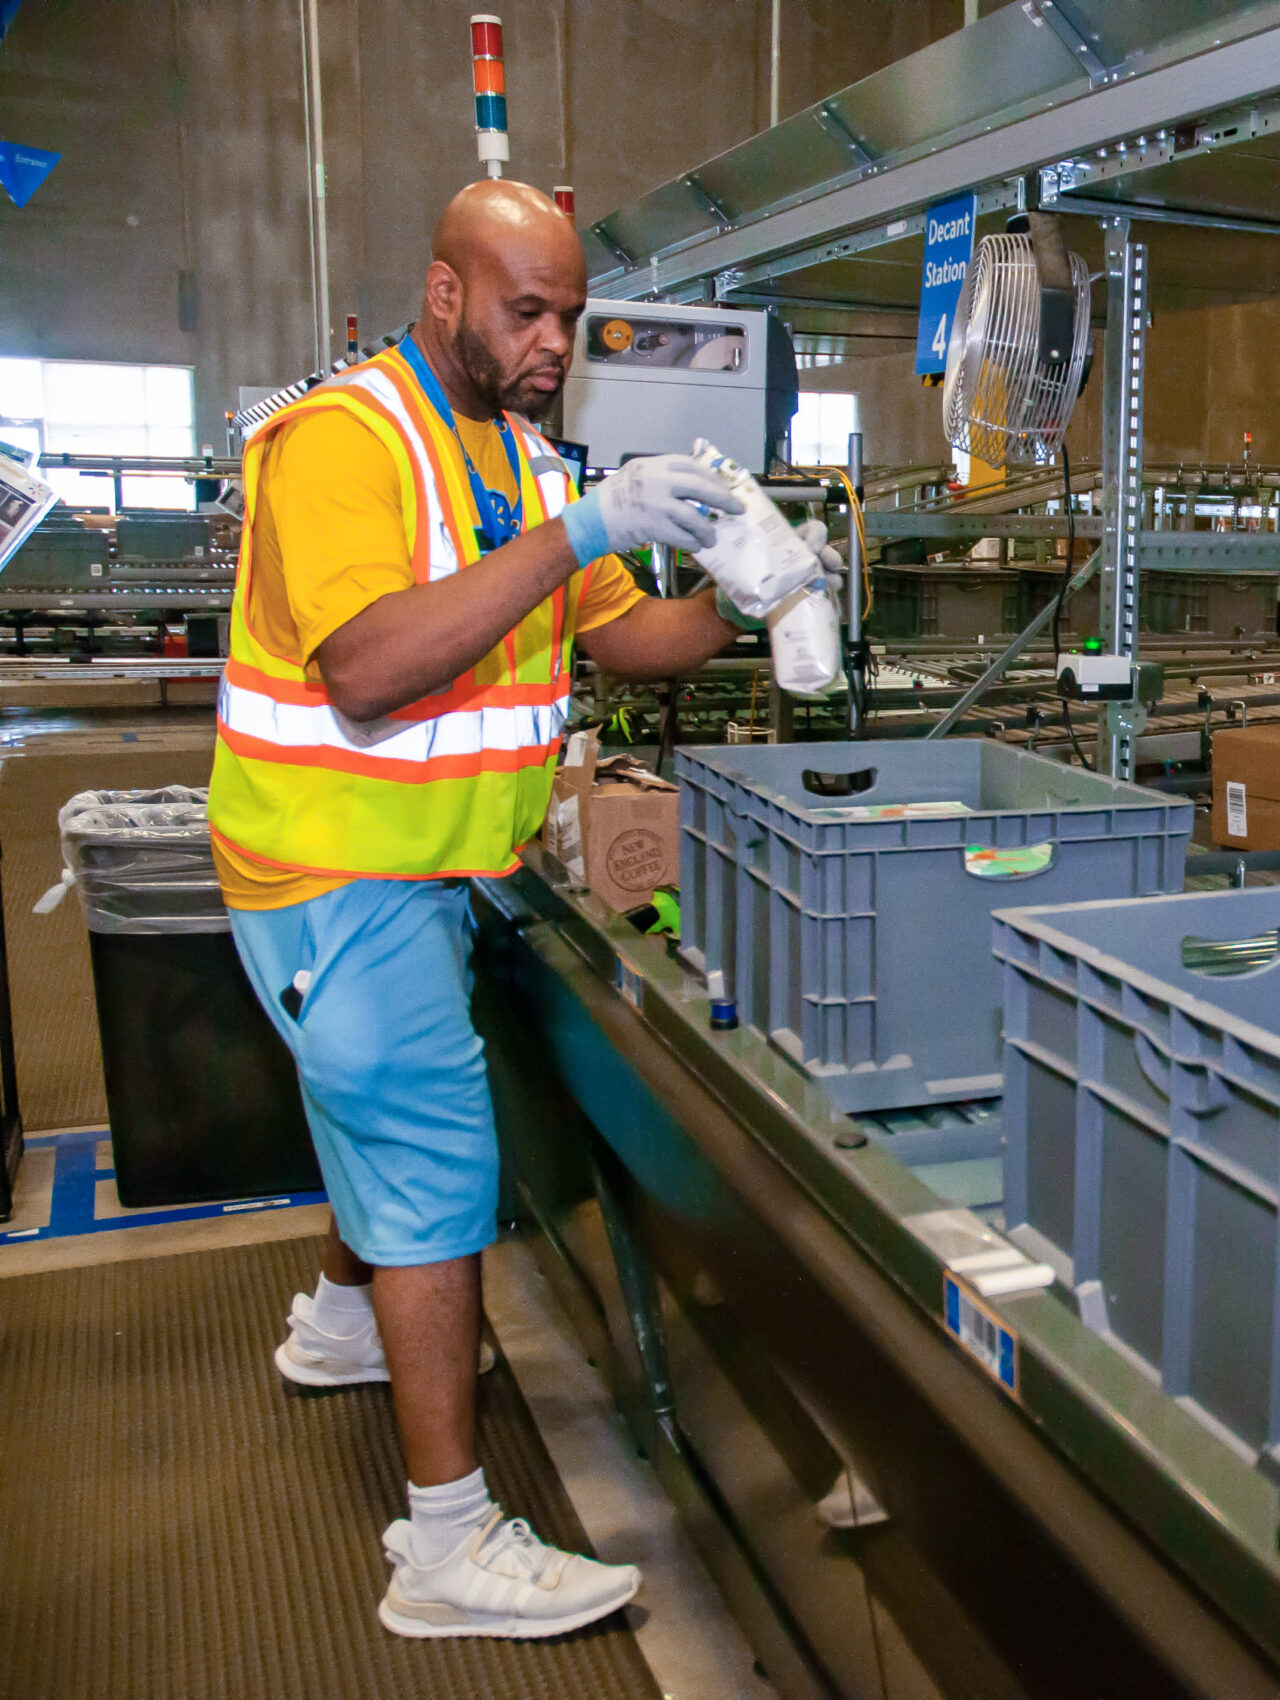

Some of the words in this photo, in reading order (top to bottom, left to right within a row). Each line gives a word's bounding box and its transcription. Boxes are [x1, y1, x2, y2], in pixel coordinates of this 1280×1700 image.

[928, 211, 971, 246] Decant
[925, 256, 967, 288] Station
[931, 313, 947, 360] 4
[614, 847, 664, 871] ENGLAND
[622, 839, 645, 856] NEW
[621, 860, 662, 881] COFFEE
